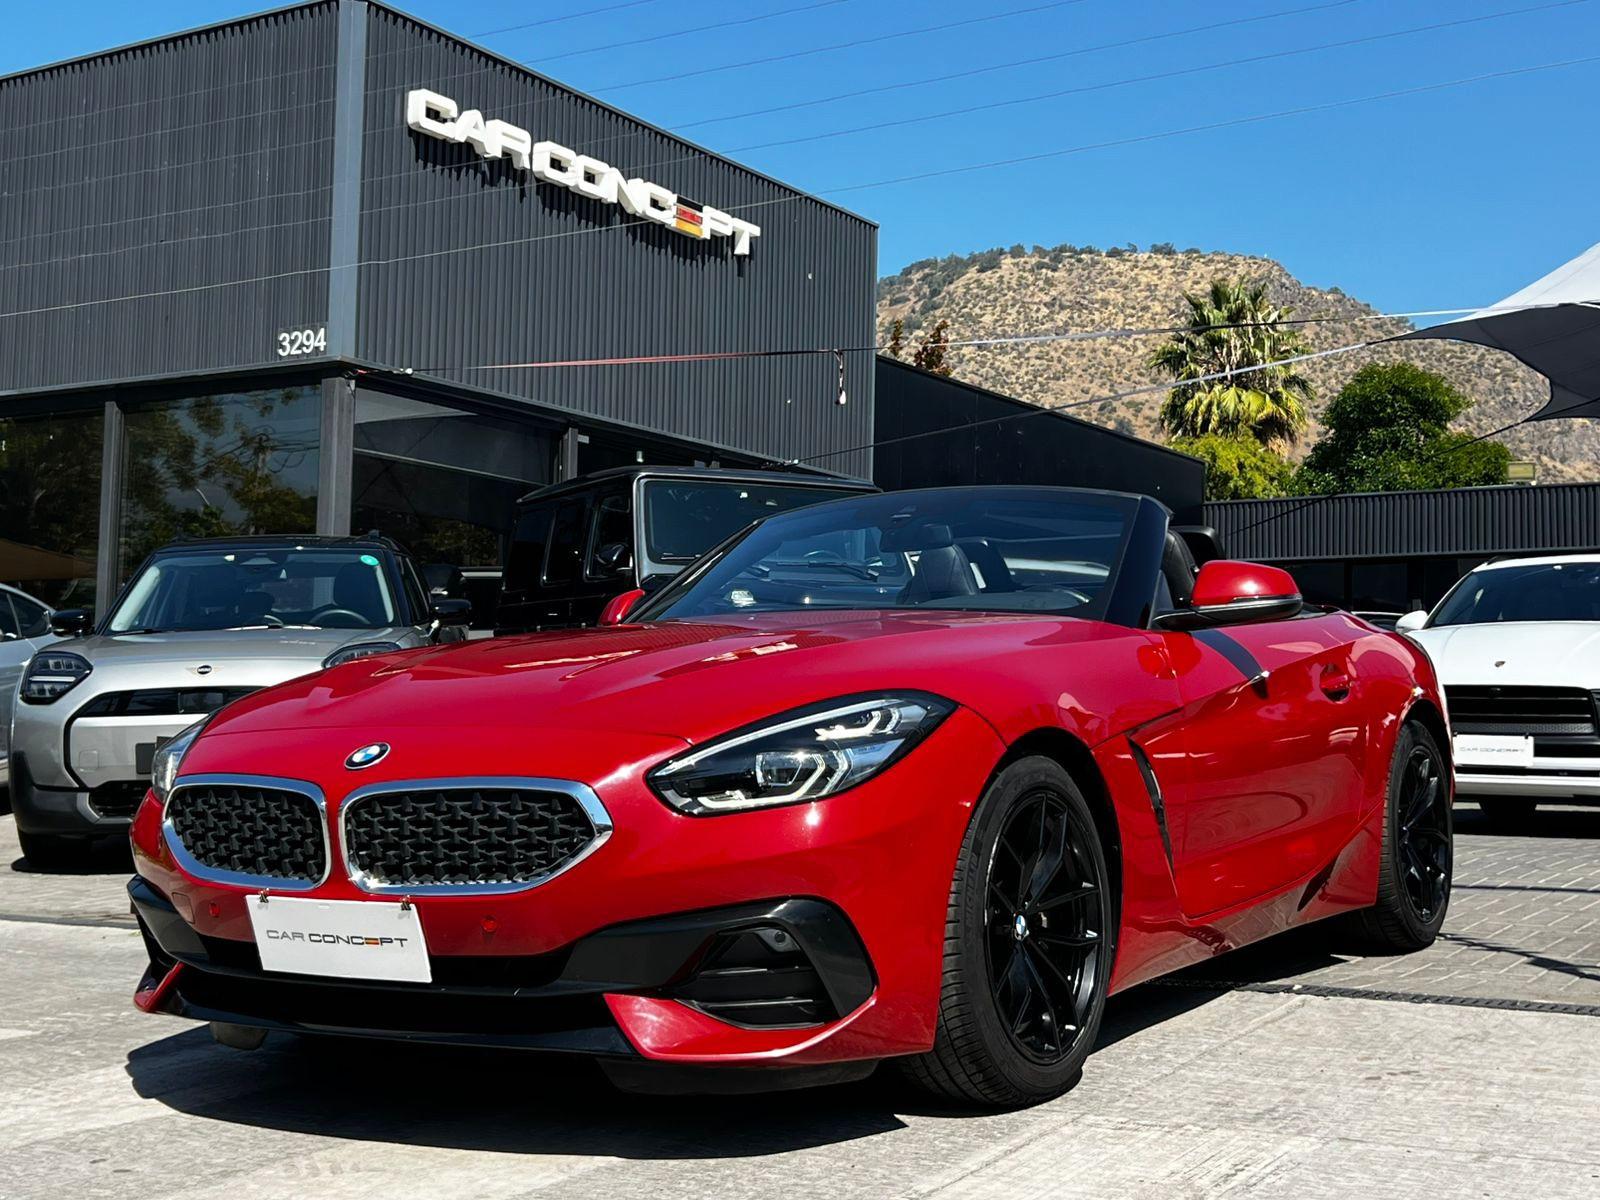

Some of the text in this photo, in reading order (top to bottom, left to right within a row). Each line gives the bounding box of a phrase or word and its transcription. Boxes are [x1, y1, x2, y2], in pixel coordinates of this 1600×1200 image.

[408, 88, 760, 255] CAR CONCEPT
[277, 327, 327, 357] 3294
[266, 929, 408, 947] CAR CONCEPT
